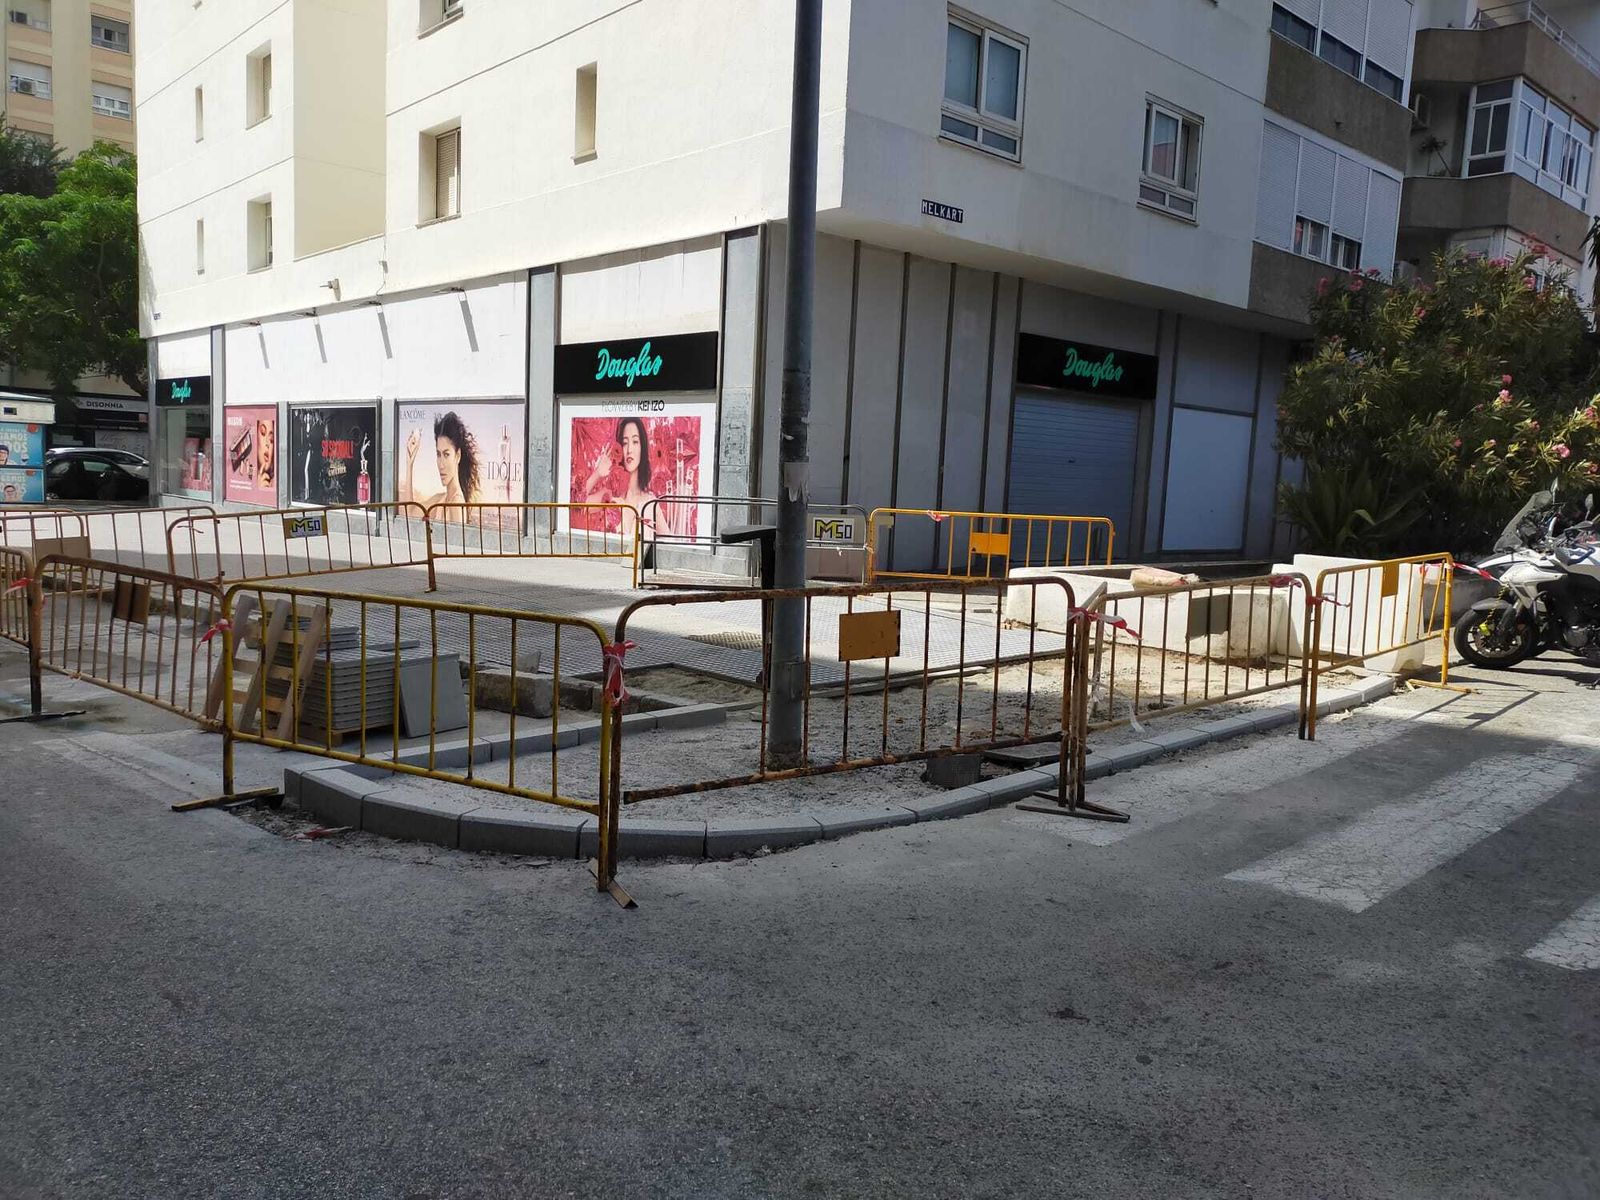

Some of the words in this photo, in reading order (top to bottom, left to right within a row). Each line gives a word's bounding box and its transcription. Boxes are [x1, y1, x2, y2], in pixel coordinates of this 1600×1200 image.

[922, 200, 963, 222] MELKART
[595, 341, 663, 388] Douglas
[1062, 347, 1124, 388] Douglas
